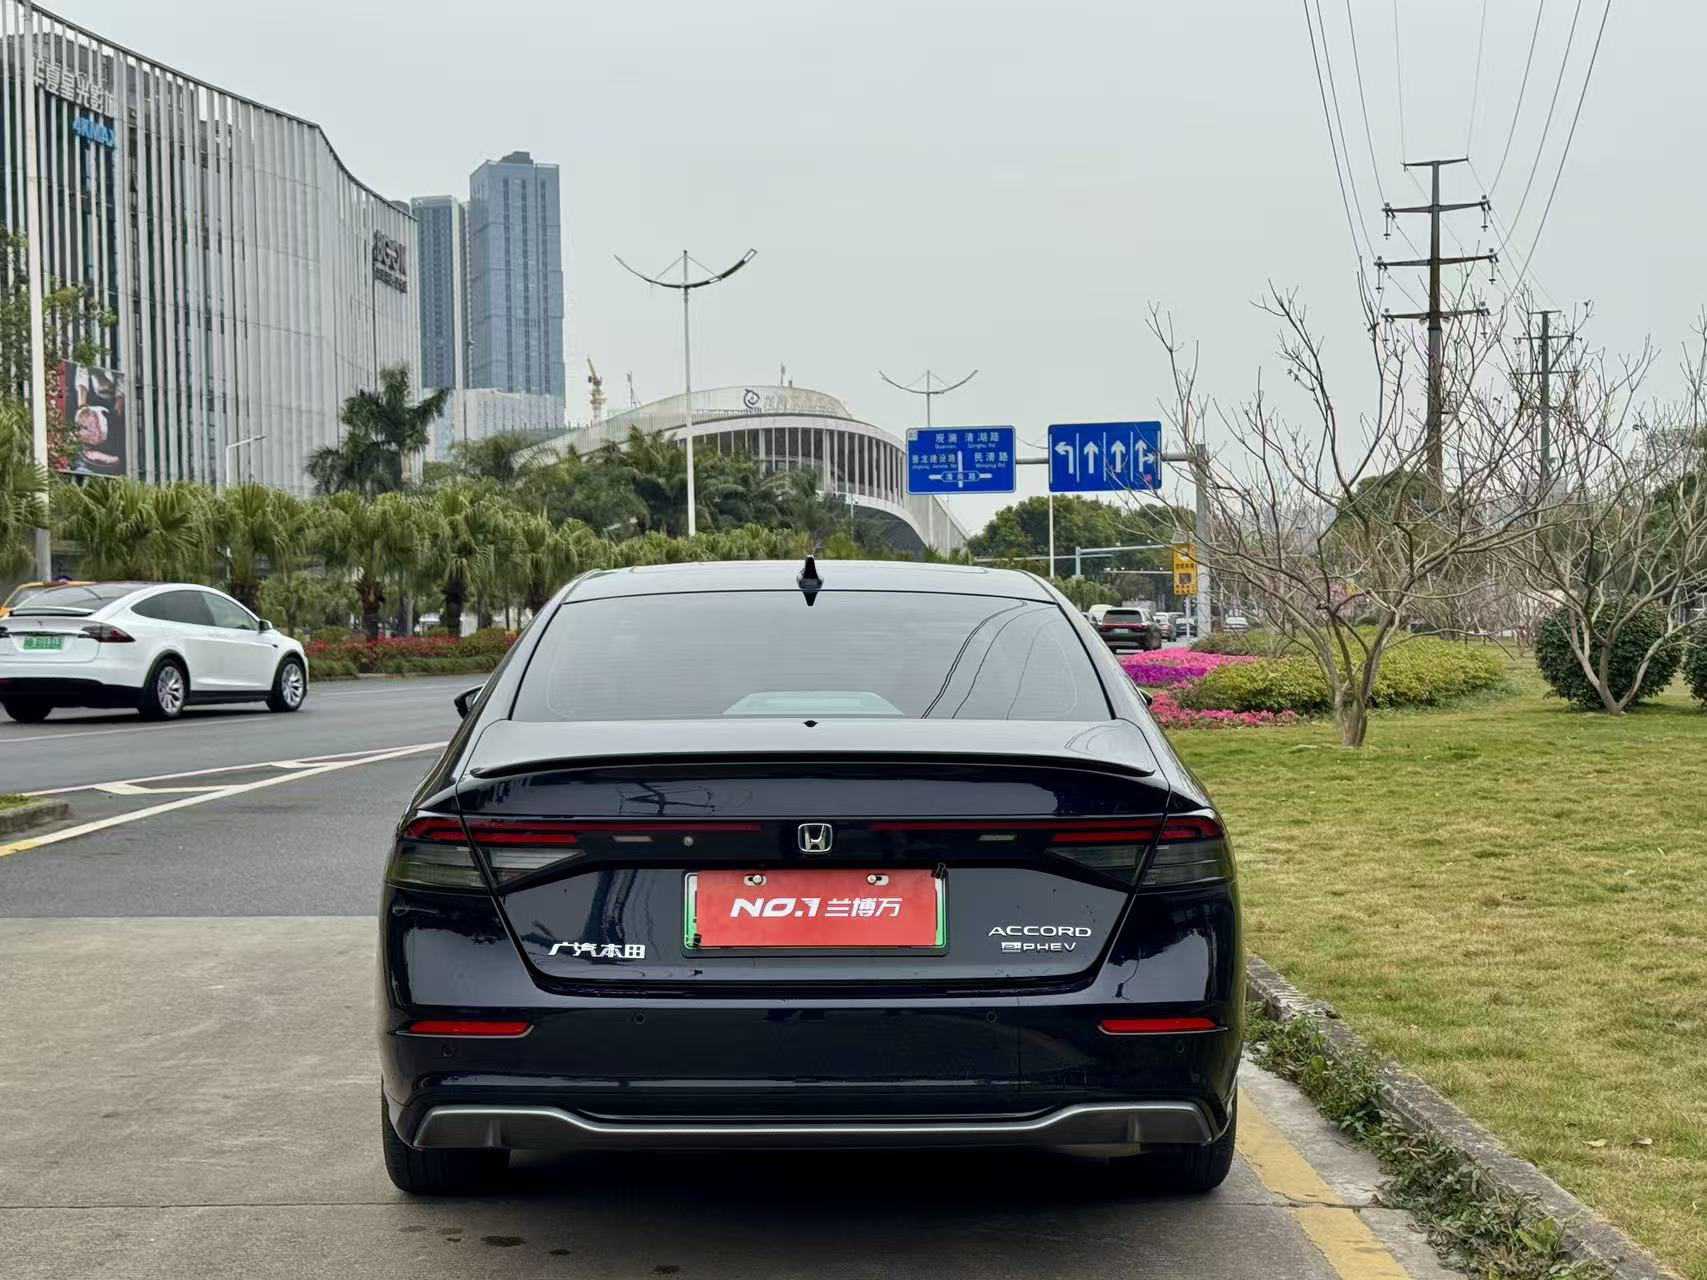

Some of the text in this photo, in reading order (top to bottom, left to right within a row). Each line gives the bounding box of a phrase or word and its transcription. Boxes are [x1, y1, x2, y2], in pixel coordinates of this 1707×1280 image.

[730, 897, 903, 918] NO.1 兰博万
[988, 925, 1092, 937] ACCORD
[547, 942, 646, 959] 广汽本田
